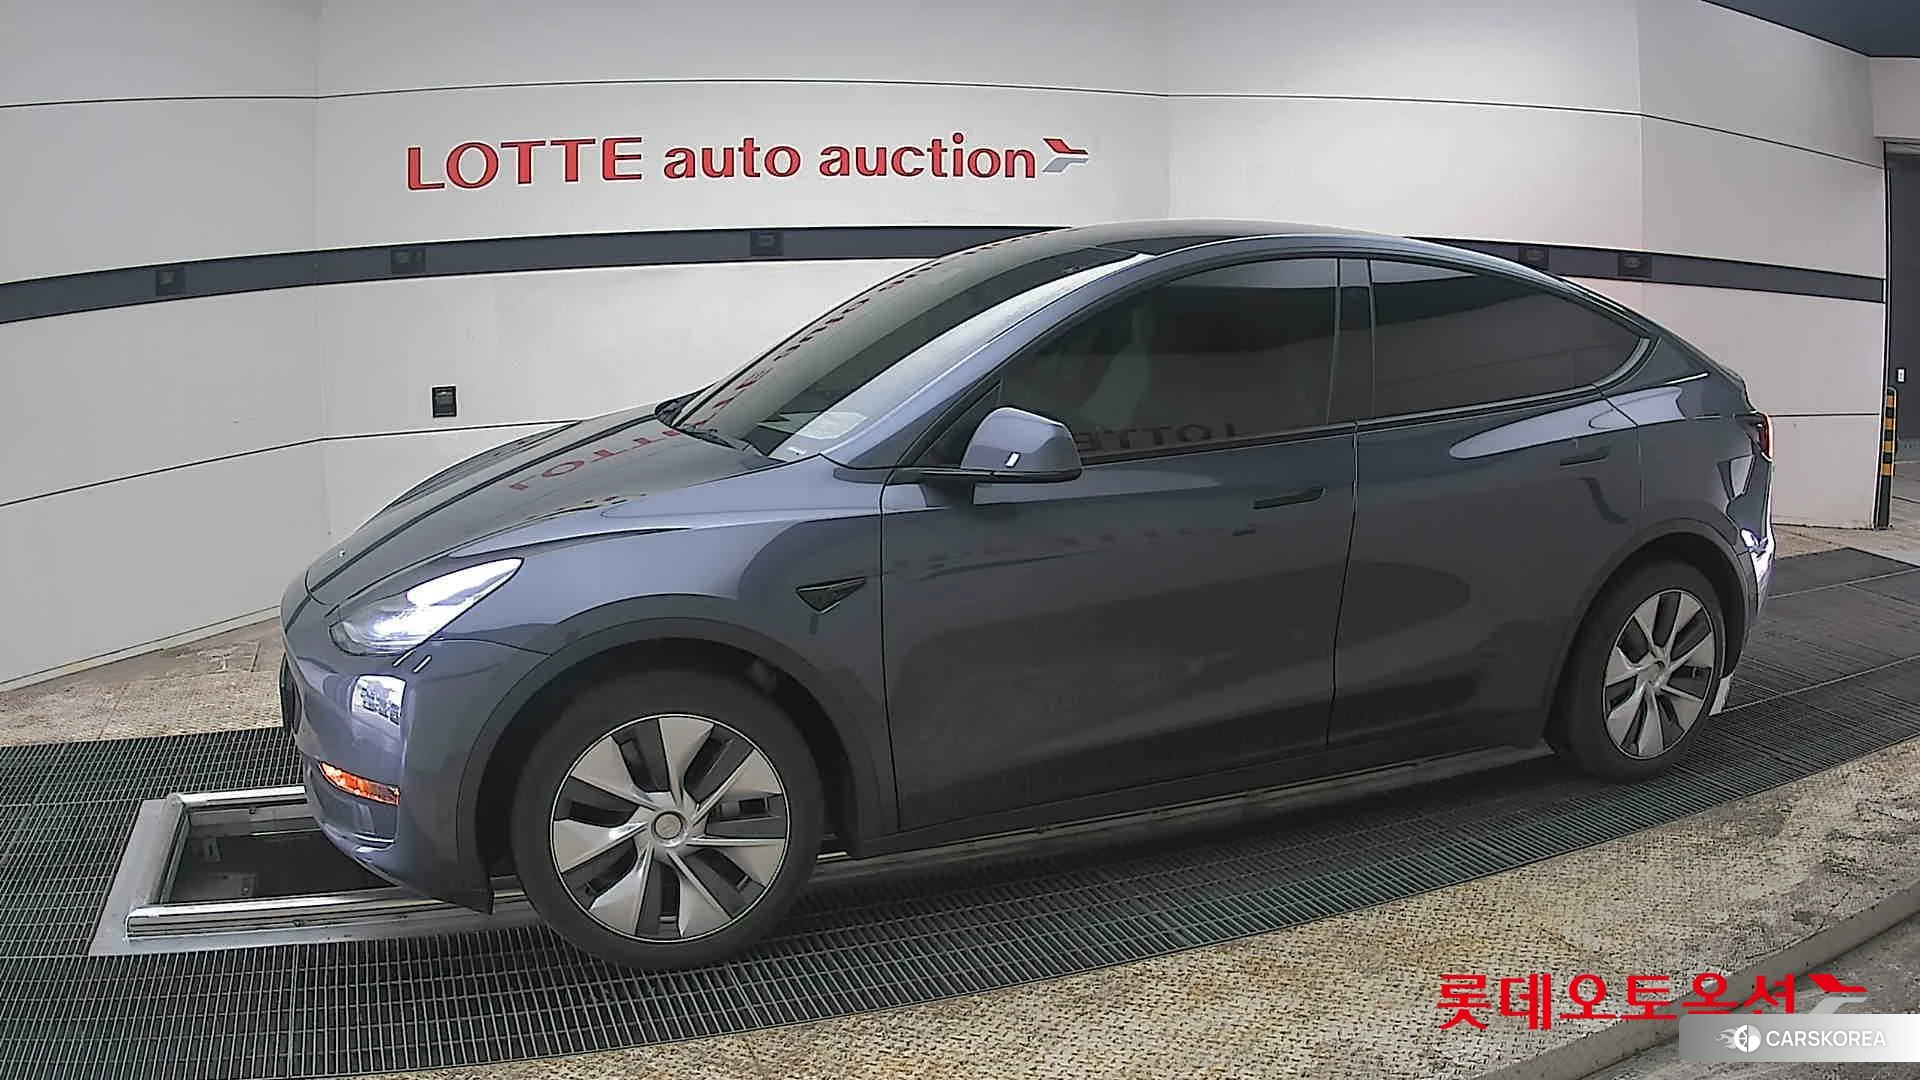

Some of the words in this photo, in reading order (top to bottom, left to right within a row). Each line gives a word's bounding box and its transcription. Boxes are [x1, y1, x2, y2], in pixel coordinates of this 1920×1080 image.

[406, 136, 641, 191] LOTTE
[663, 137, 802, 181] auto
[818, 132, 1037, 179] auction
